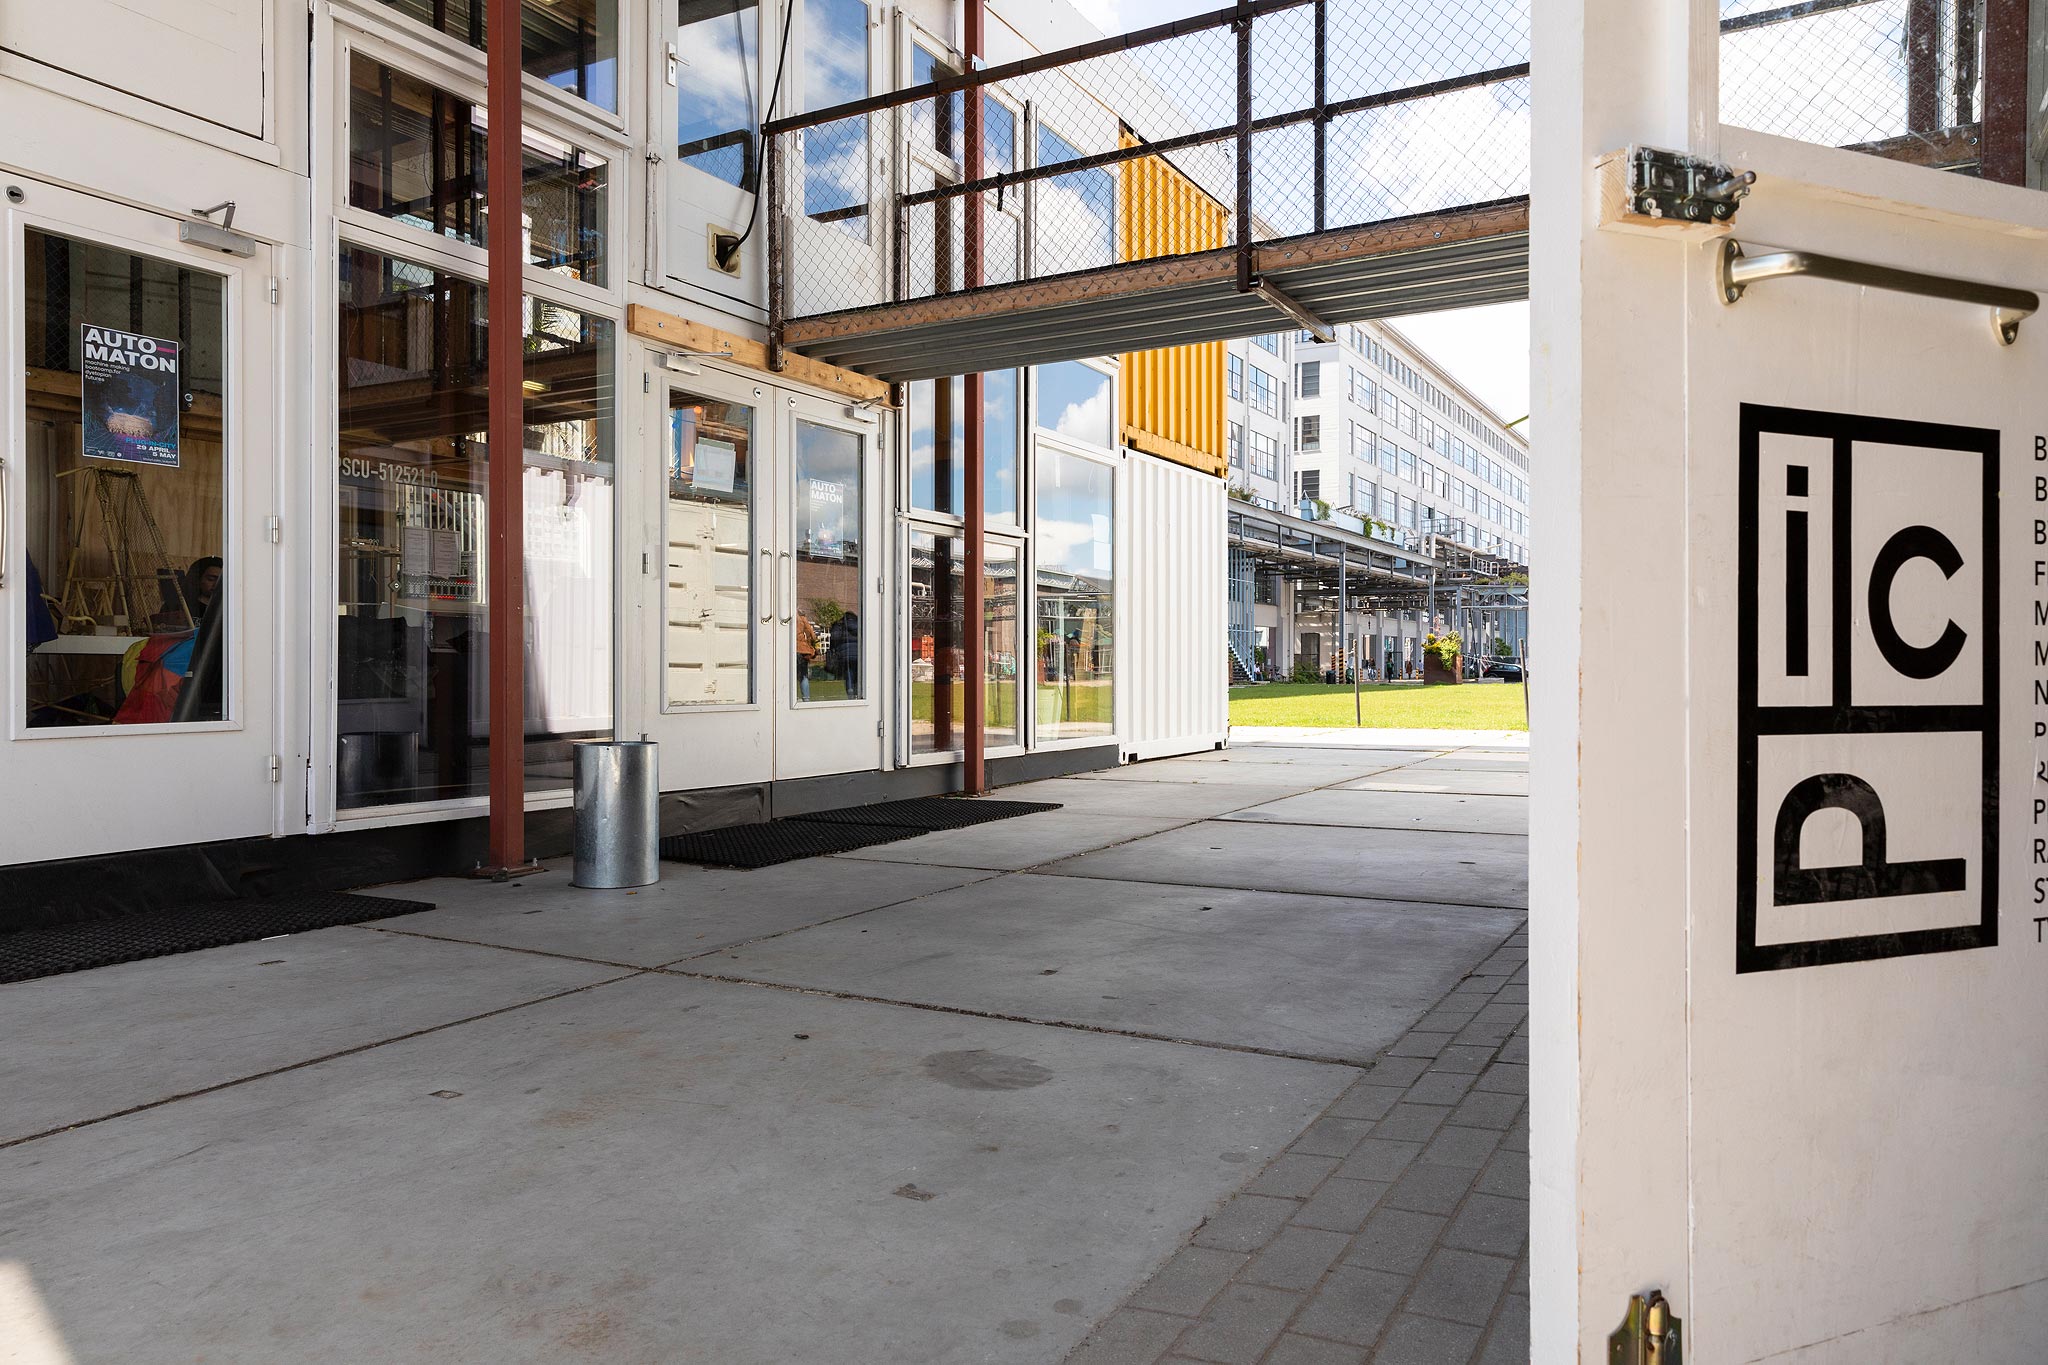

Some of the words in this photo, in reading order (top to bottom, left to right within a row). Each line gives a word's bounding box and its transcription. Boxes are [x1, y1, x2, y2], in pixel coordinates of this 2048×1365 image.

[85, 344, 176, 374] MATON
[110, 364, 130, 372] making
[85, 374, 105, 382] futures
[126, 437, 176, 449] PLUG-IN-CITY
[339, 457, 425, 485] SCU-512521
[811, 489, 842, 504] MATON
